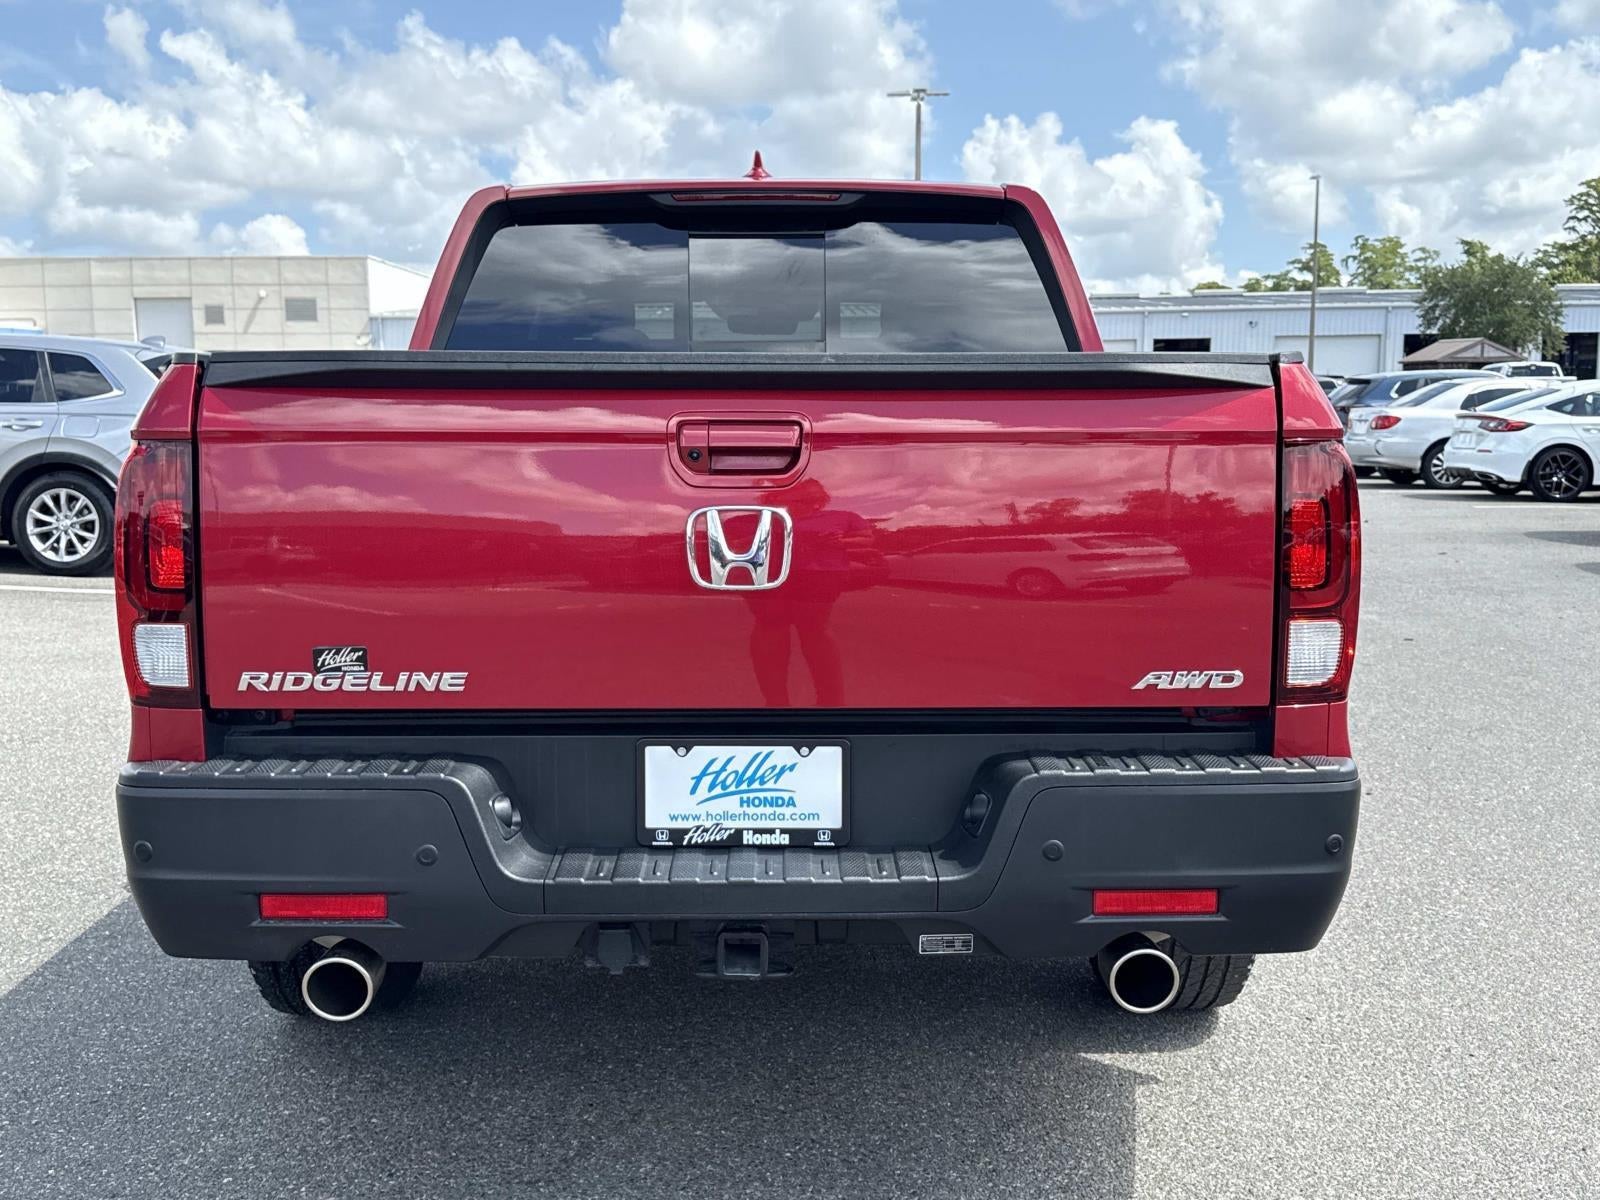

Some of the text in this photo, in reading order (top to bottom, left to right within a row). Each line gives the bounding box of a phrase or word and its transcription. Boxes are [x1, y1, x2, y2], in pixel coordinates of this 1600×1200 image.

[317, 647, 363, 667] Holler
[237, 671, 469, 692] RIDGELINE
[1131, 670, 1244, 690] AWD
[689, 750, 799, 795] Holler
[739, 796, 796, 808] HONDA
[668, 811, 820, 822] www.hollerhonda.com
[682, 823, 790, 846] Holler Honda
